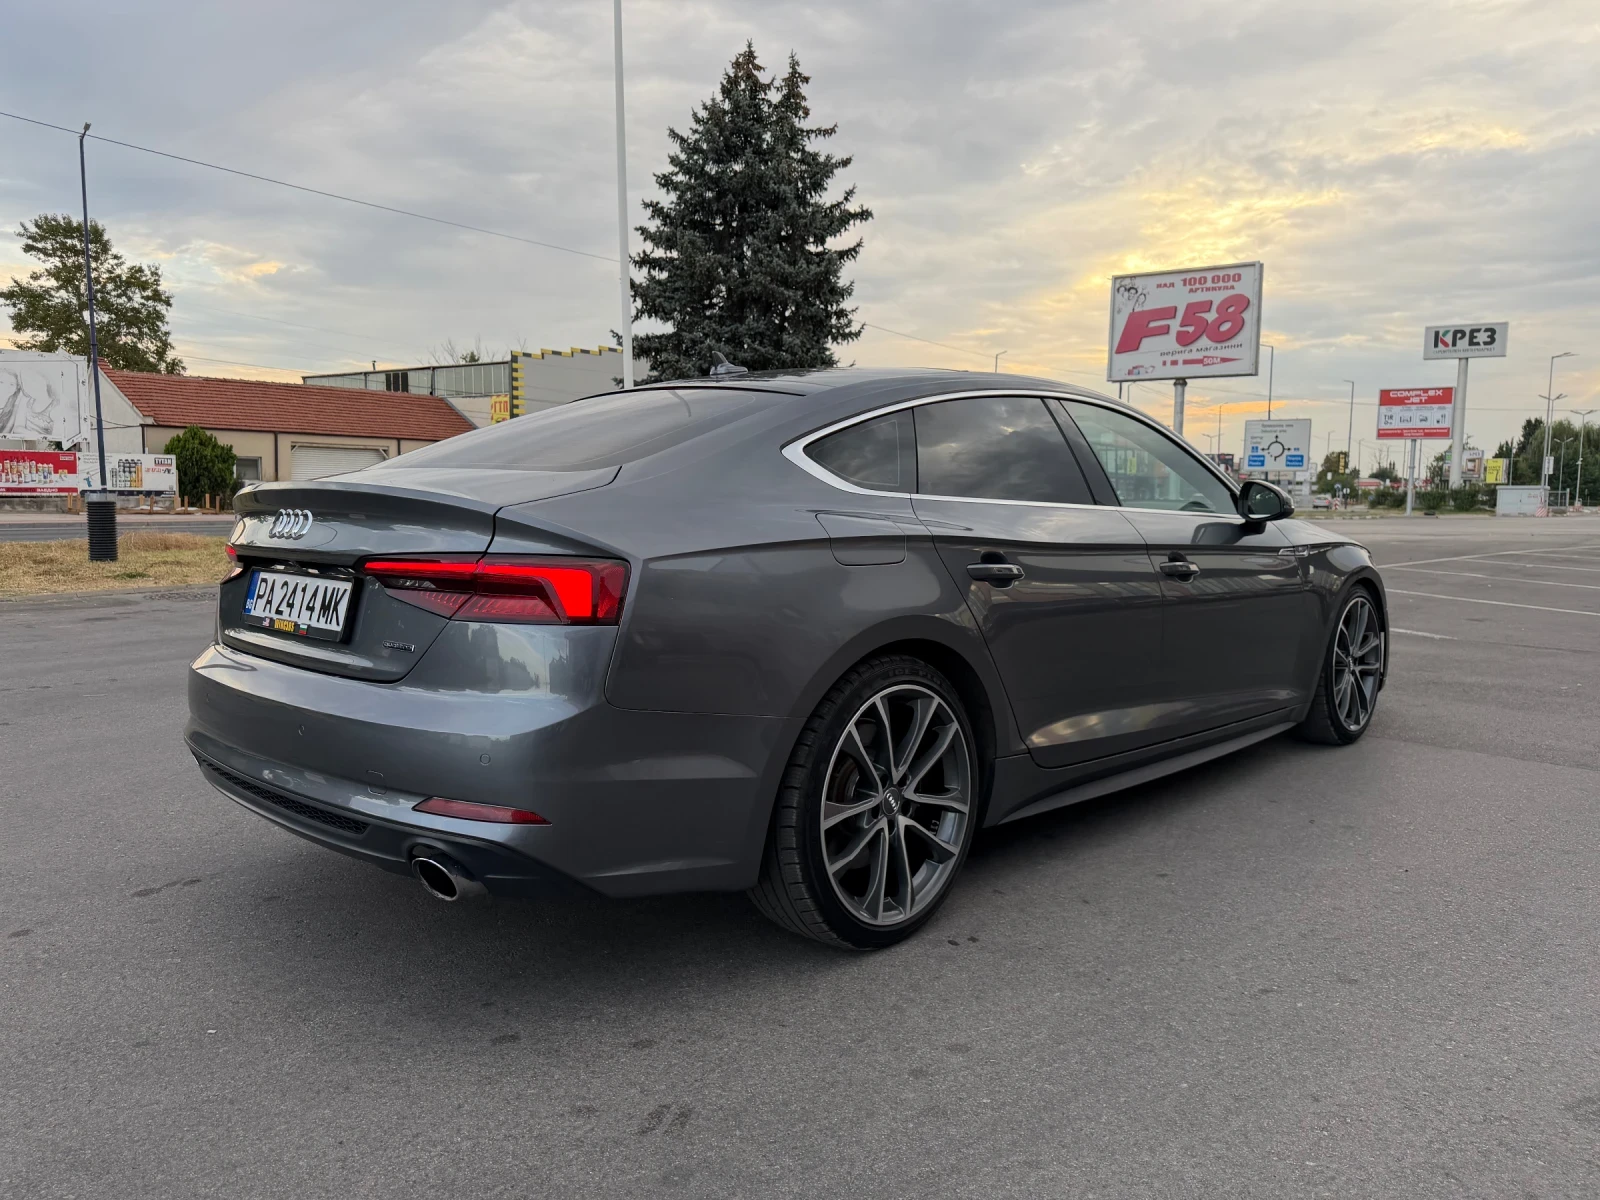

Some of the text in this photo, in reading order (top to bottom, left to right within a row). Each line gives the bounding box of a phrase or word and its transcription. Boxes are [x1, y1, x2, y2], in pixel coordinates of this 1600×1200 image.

[1181, 276, 1208, 287] 100
[1211, 272, 1242, 284] 000
[1188, 284, 1235, 294] АРТИКУЛА
[1115, 293, 1251, 354] F58
[1433, 327, 1497, 349] КРЕЗ
[1389, 389, 1443, 398] COMPLEX
[245, 598, 254, 610] BG
